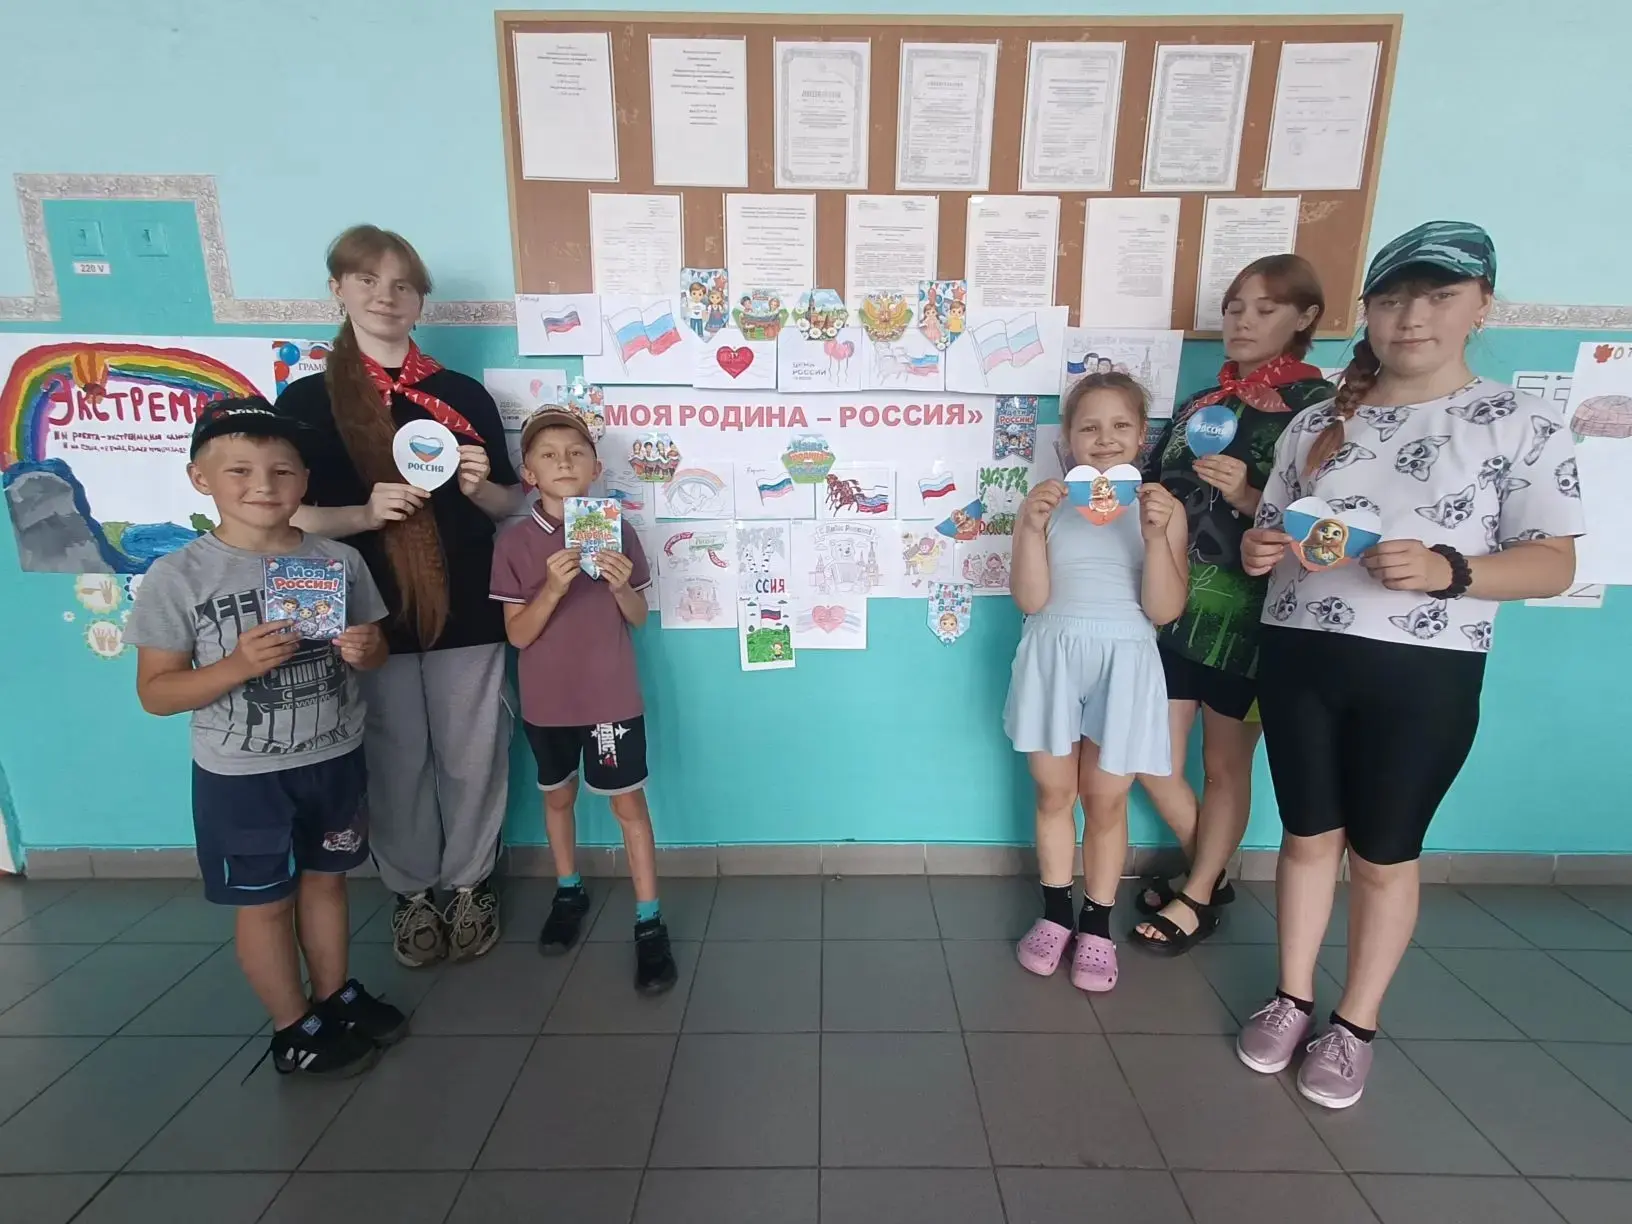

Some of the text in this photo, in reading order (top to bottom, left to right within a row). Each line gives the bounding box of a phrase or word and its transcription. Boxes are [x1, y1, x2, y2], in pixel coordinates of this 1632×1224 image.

[80, 264, 104, 273] 220 V
[43, 373, 236, 425] ЭКСТРЕМА
[605, 405, 672, 426] МОЯ
[679, 405, 808, 431] РОДИНА
[840, 404, 983, 427] РОССИЯ»
[408, 463, 444, 472] РОССИЯ
[193, 590, 266, 622] KEE
